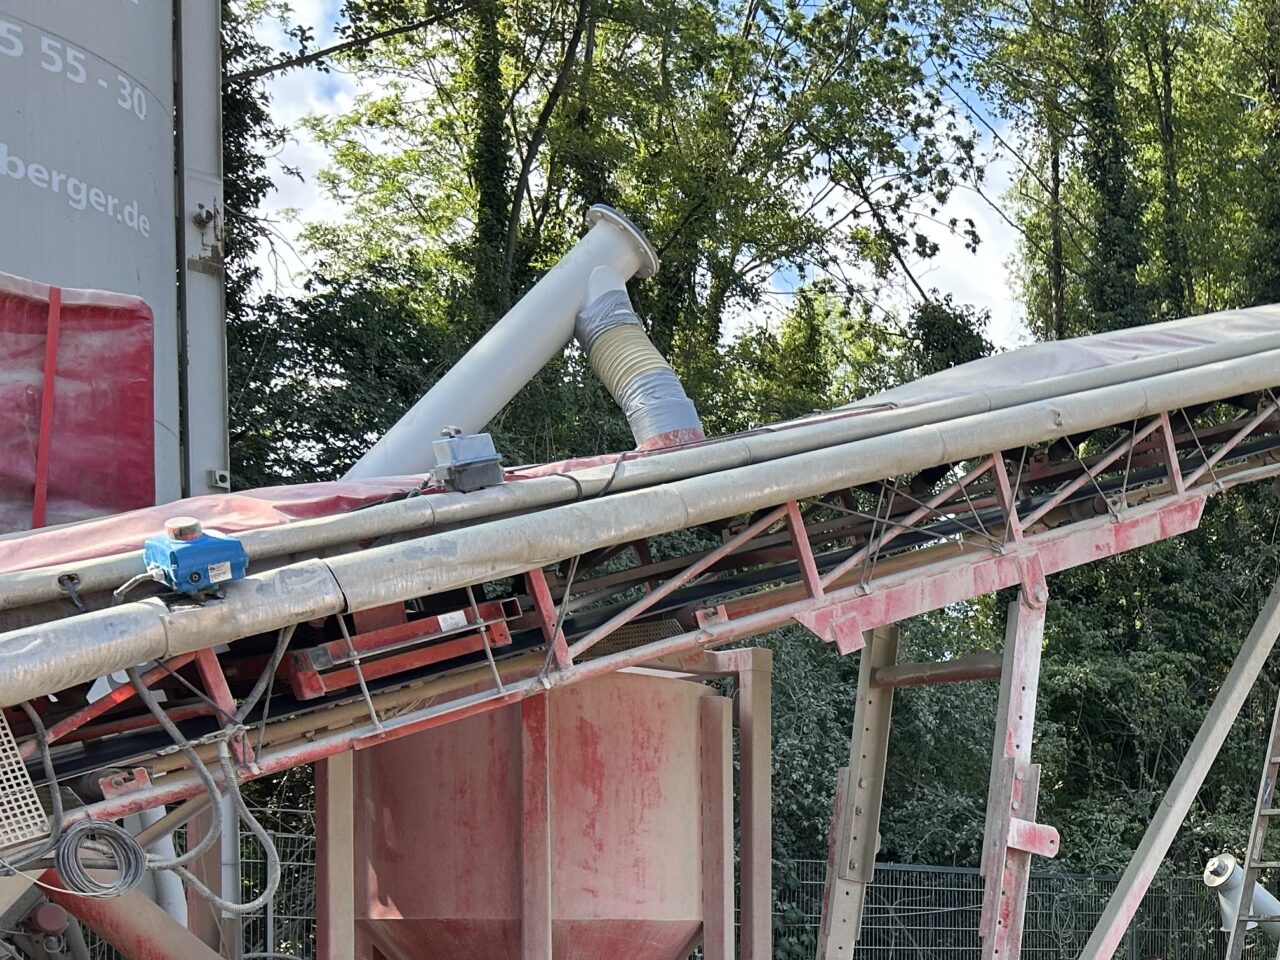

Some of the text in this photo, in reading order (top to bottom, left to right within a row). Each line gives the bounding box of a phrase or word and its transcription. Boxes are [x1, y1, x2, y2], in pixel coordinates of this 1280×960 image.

[40, 35, 87, 84] 55
[117, 73, 147, 120] 30
[0, 142, 150, 238] berger.de
